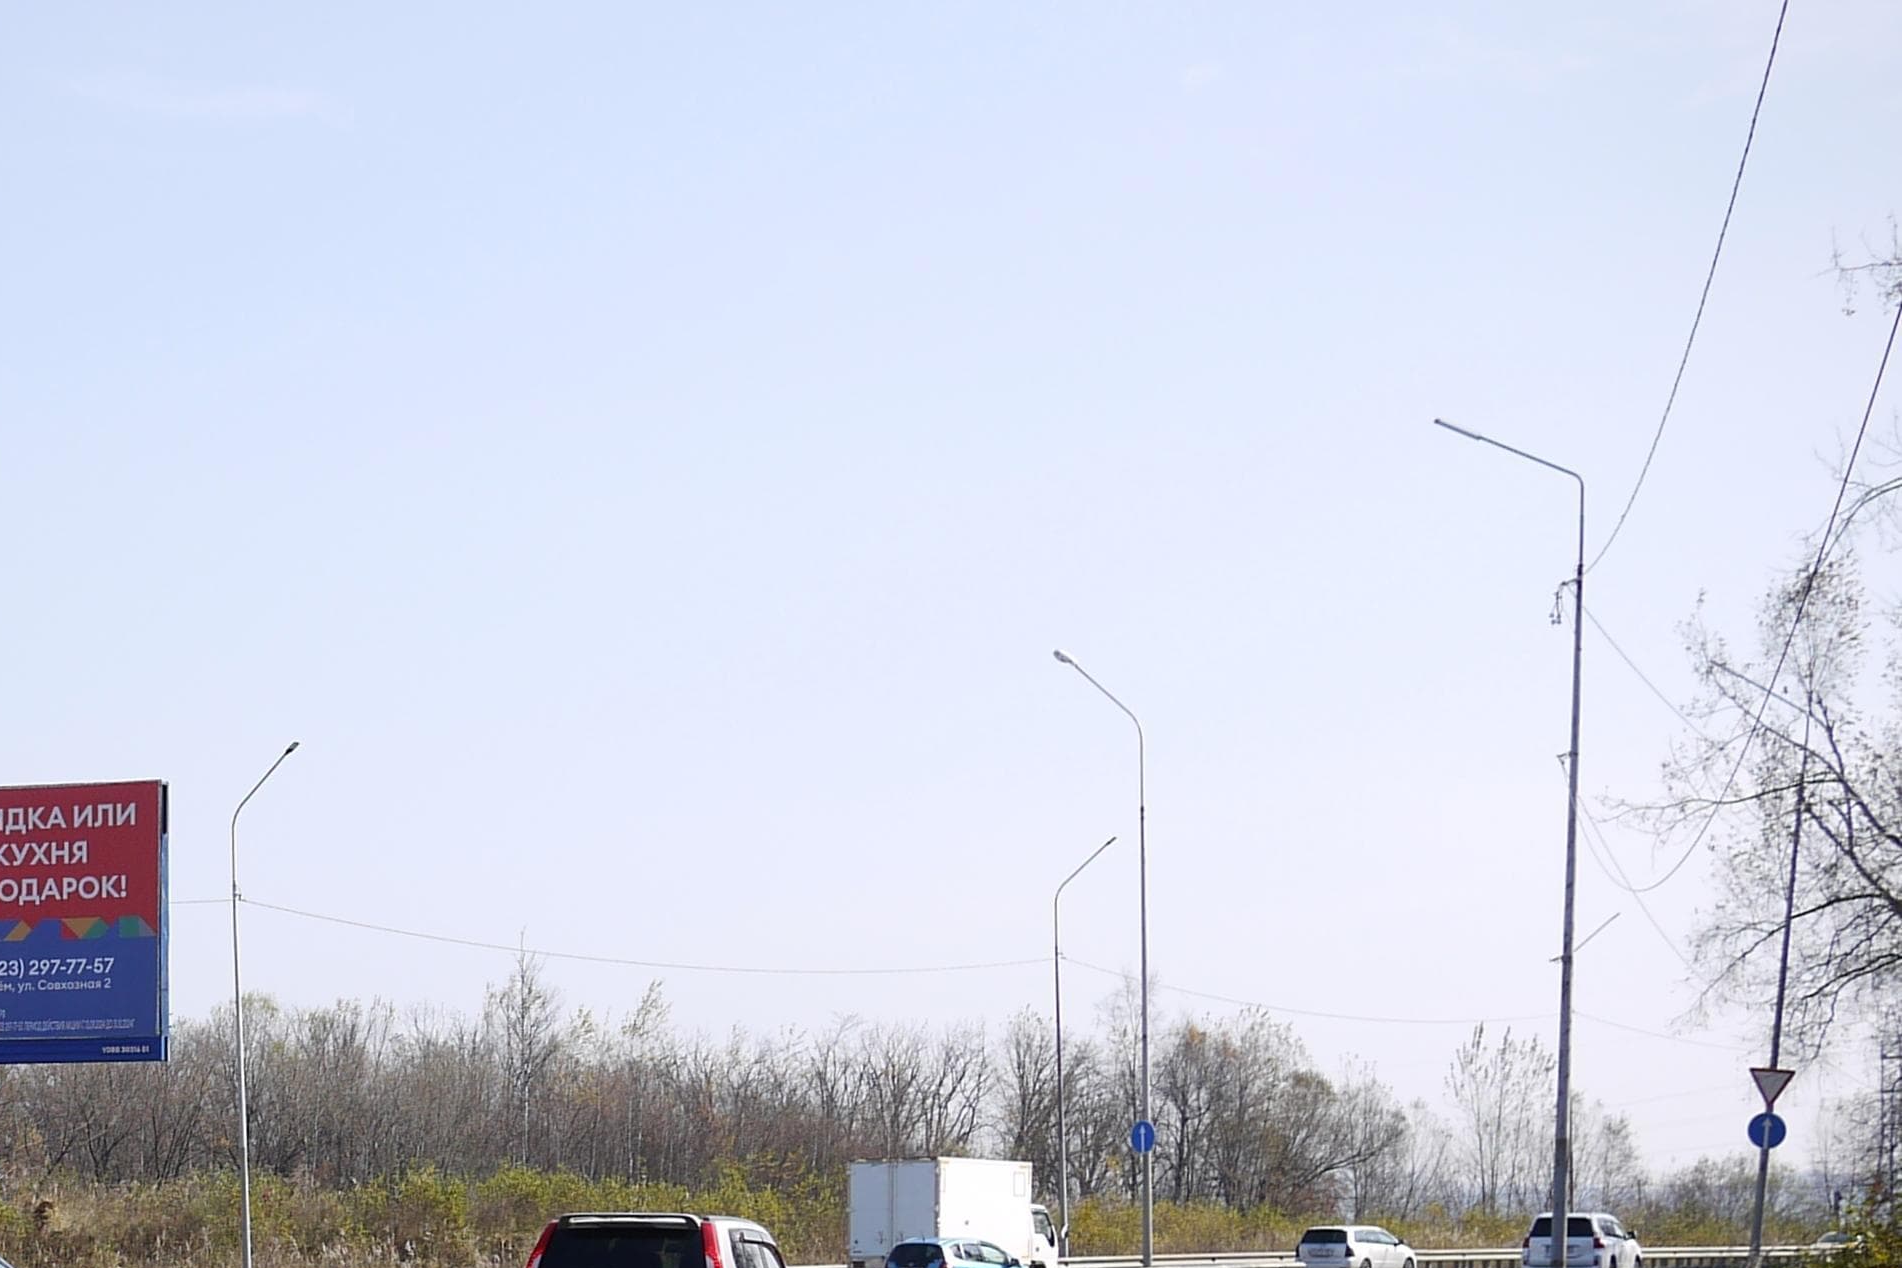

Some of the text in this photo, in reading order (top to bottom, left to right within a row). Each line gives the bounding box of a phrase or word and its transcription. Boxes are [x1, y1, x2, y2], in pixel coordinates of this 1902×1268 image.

[73, 802, 137, 827] ИЛИ
[28, 957, 115, 976] 297-77-57
[17, 981, 35, 994] ул.
[37, 979, 101, 991] Совхозная
[104, 977, 112, 989] 2
